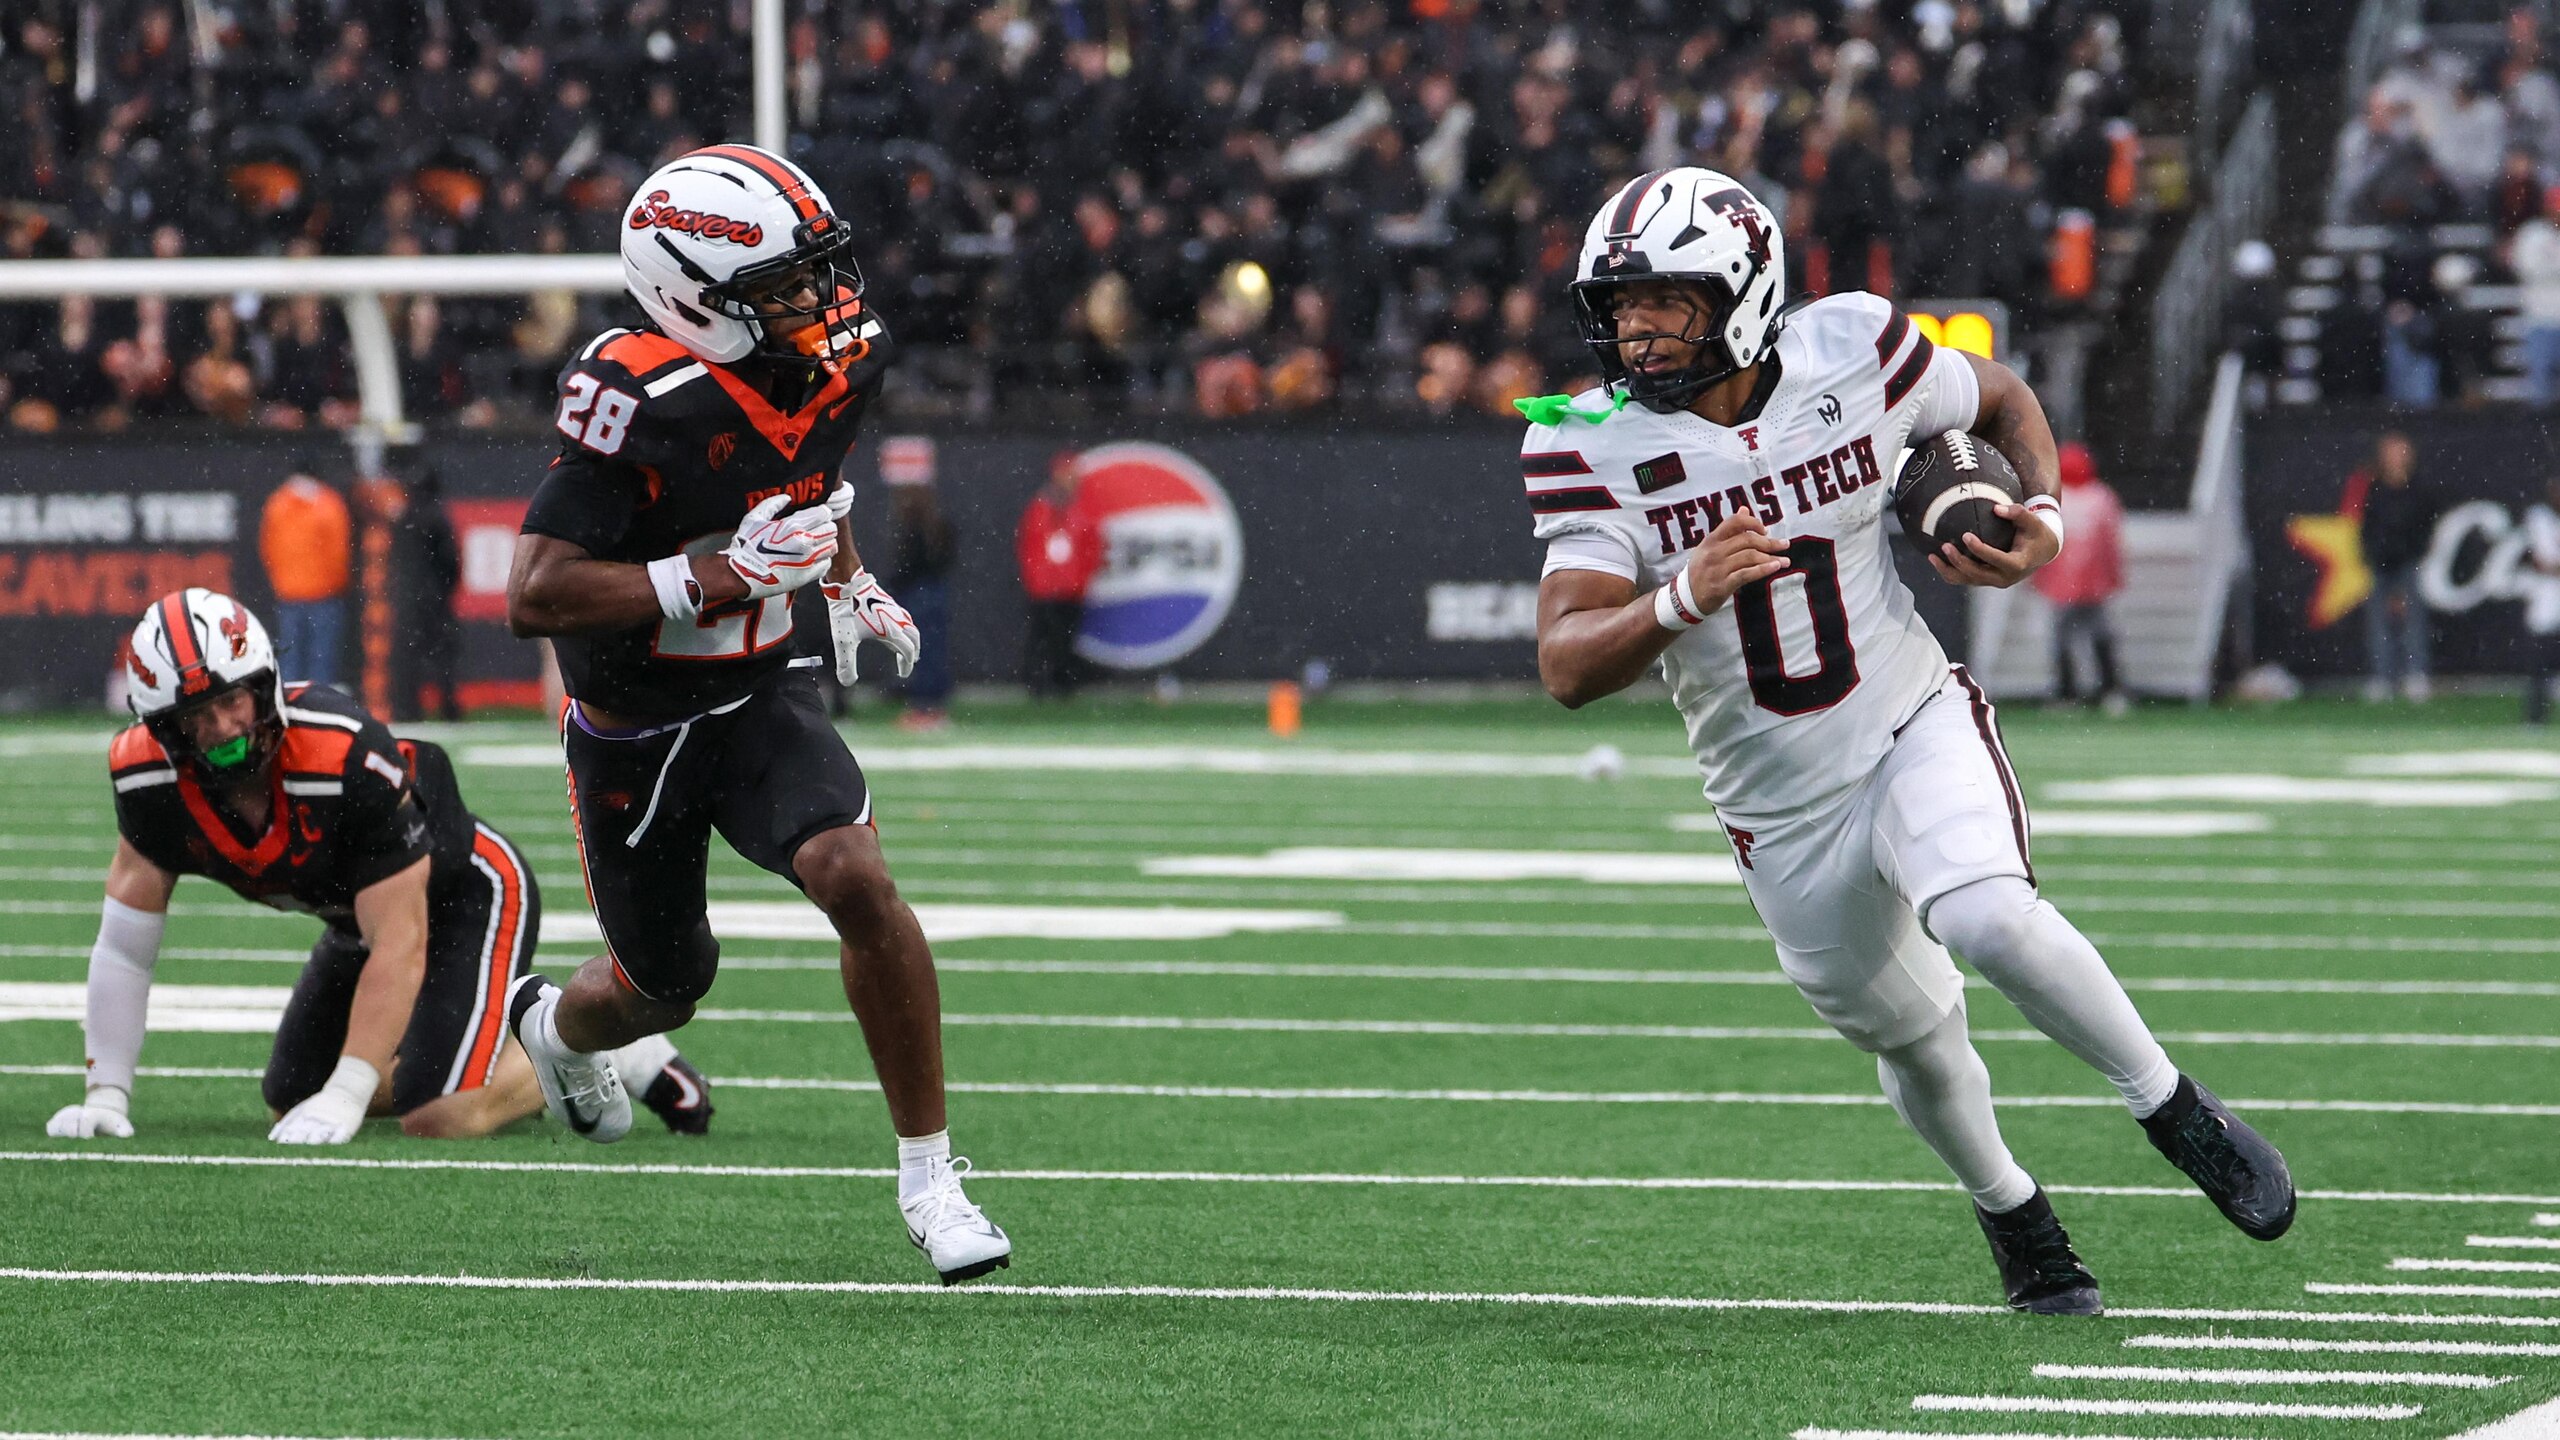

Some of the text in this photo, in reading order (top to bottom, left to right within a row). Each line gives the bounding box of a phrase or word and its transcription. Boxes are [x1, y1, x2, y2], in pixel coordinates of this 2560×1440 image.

[629, 189, 763, 247] Beavers
[811, 217, 829, 233] OSU
[556, 371, 640, 455] 28
[1644, 476, 1784, 555] TEXAS
[1780, 433, 1882, 515] TECH
[1733, 534, 1861, 717] 0
[364, 750, 404, 789] 1
